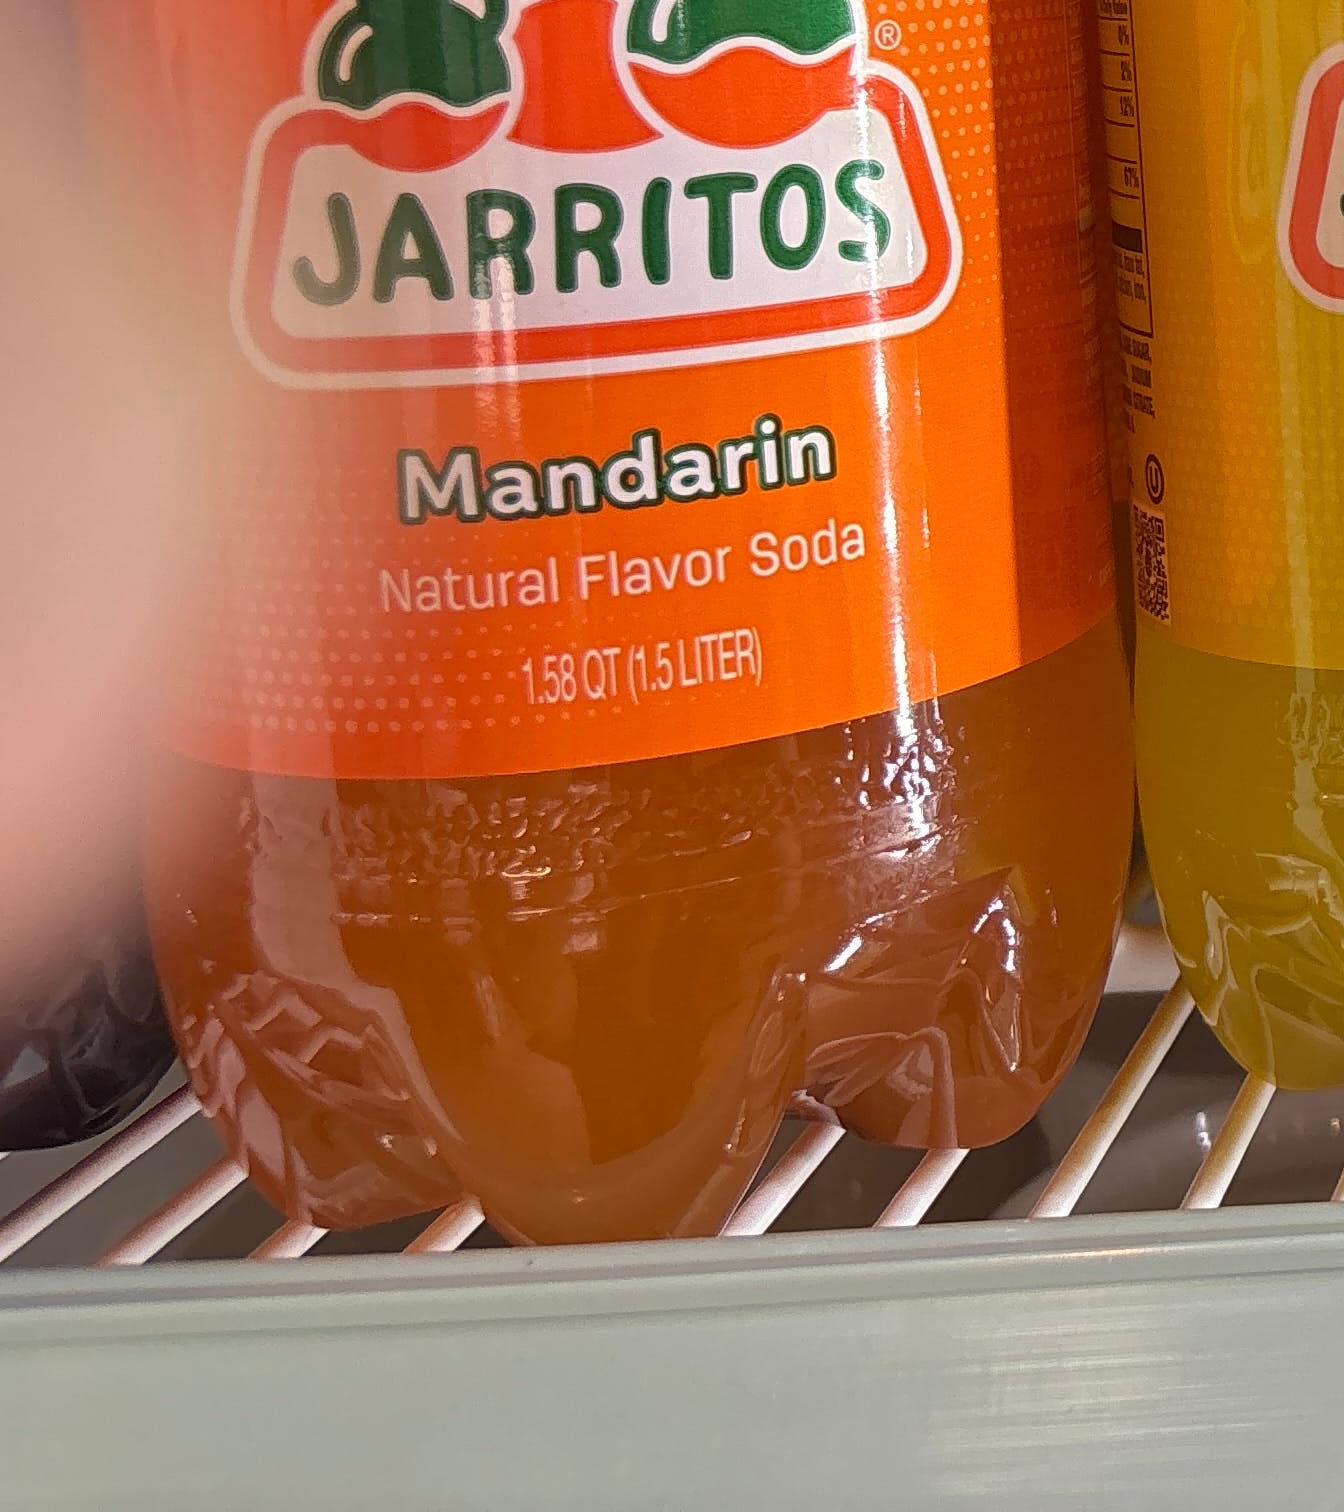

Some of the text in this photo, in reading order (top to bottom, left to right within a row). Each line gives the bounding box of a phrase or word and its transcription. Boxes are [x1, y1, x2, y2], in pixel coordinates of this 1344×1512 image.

[295, 158, 892, 305] JARRITOS
[397, 414, 837, 526] Mandarin
[380, 519, 868, 616] Natural Flavor Soda
[522, 627, 762, 705] 1.58 QT (1.5 LITER)
